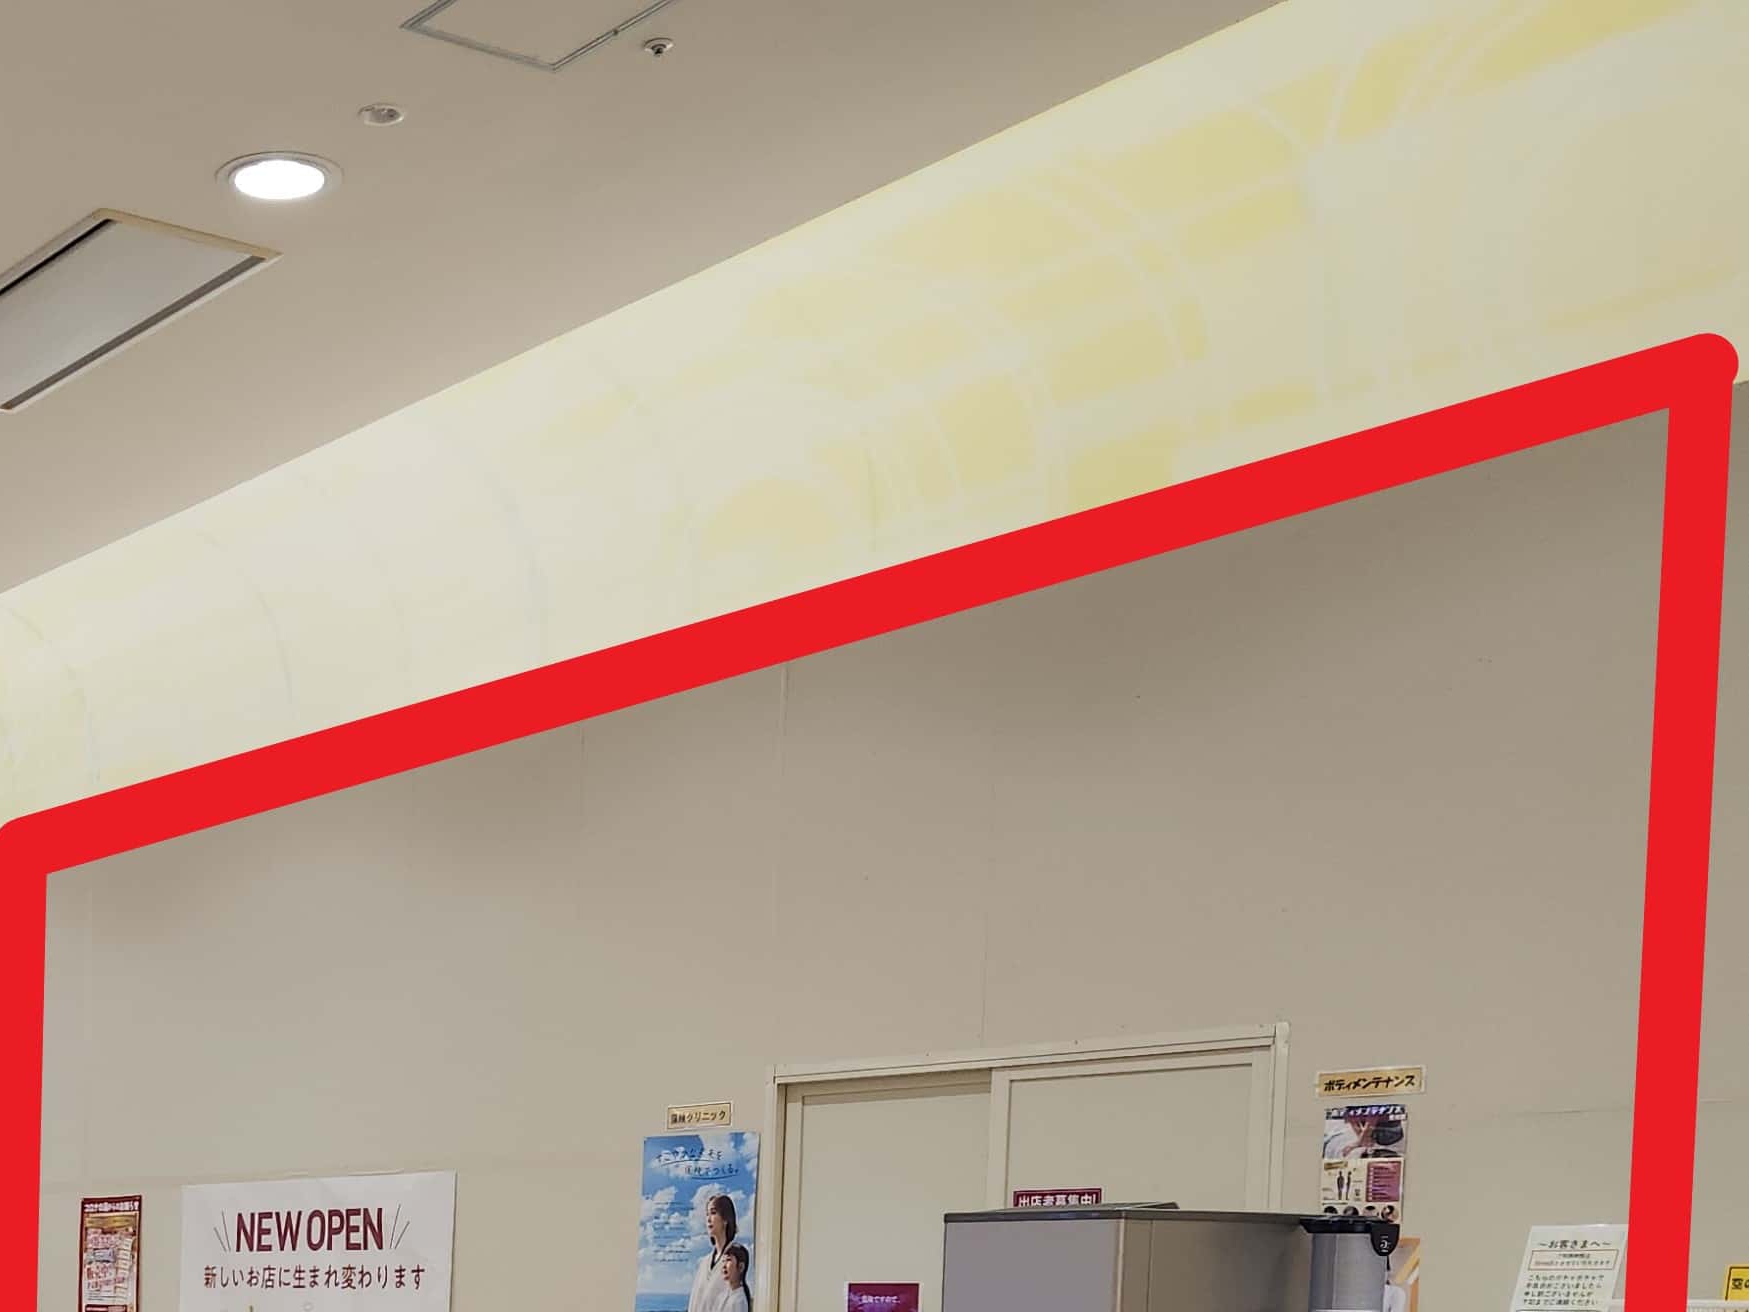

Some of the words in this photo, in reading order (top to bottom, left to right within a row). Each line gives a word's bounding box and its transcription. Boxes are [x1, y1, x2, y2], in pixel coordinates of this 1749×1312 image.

[1324, 1074, 1415, 1091] ボディメンテナンス
[236, 1211, 302, 1252] NEW
[306, 1208, 384, 1251] OPEN
[204, 1264, 425, 1290] 新しいお店に生まれ変わります
